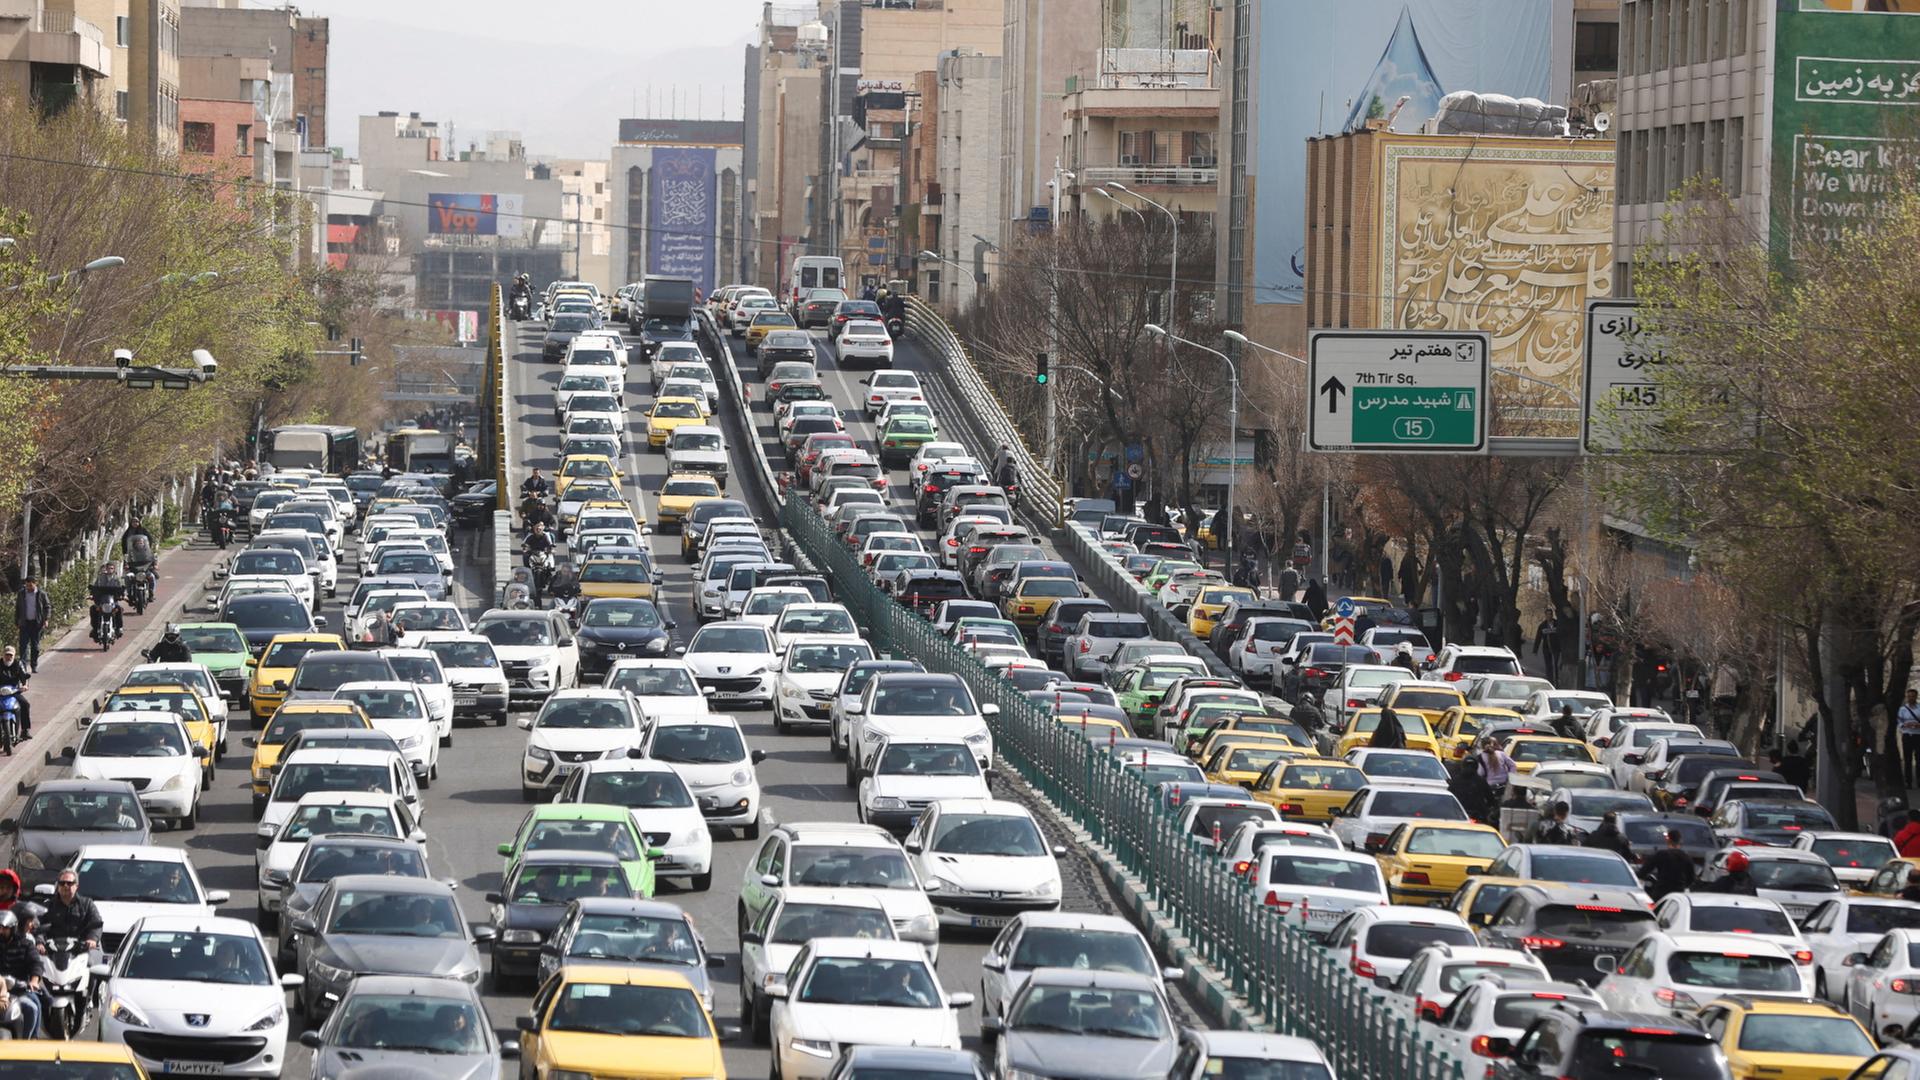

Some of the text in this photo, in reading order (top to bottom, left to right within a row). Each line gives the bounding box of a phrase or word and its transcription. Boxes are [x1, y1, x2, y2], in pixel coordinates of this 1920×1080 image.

[1805, 68, 1864, 96] زمین
[1867, 74, 1894, 99] به
[1803, 172, 1840, 193] We
[1389, 344, 1452, 363] هفتم تیر
[1356, 373, 1417, 386] 7th Tir Sq.
[1358, 392, 1451, 410] شهید مدرس
[1404, 420, 1423, 436] 15
